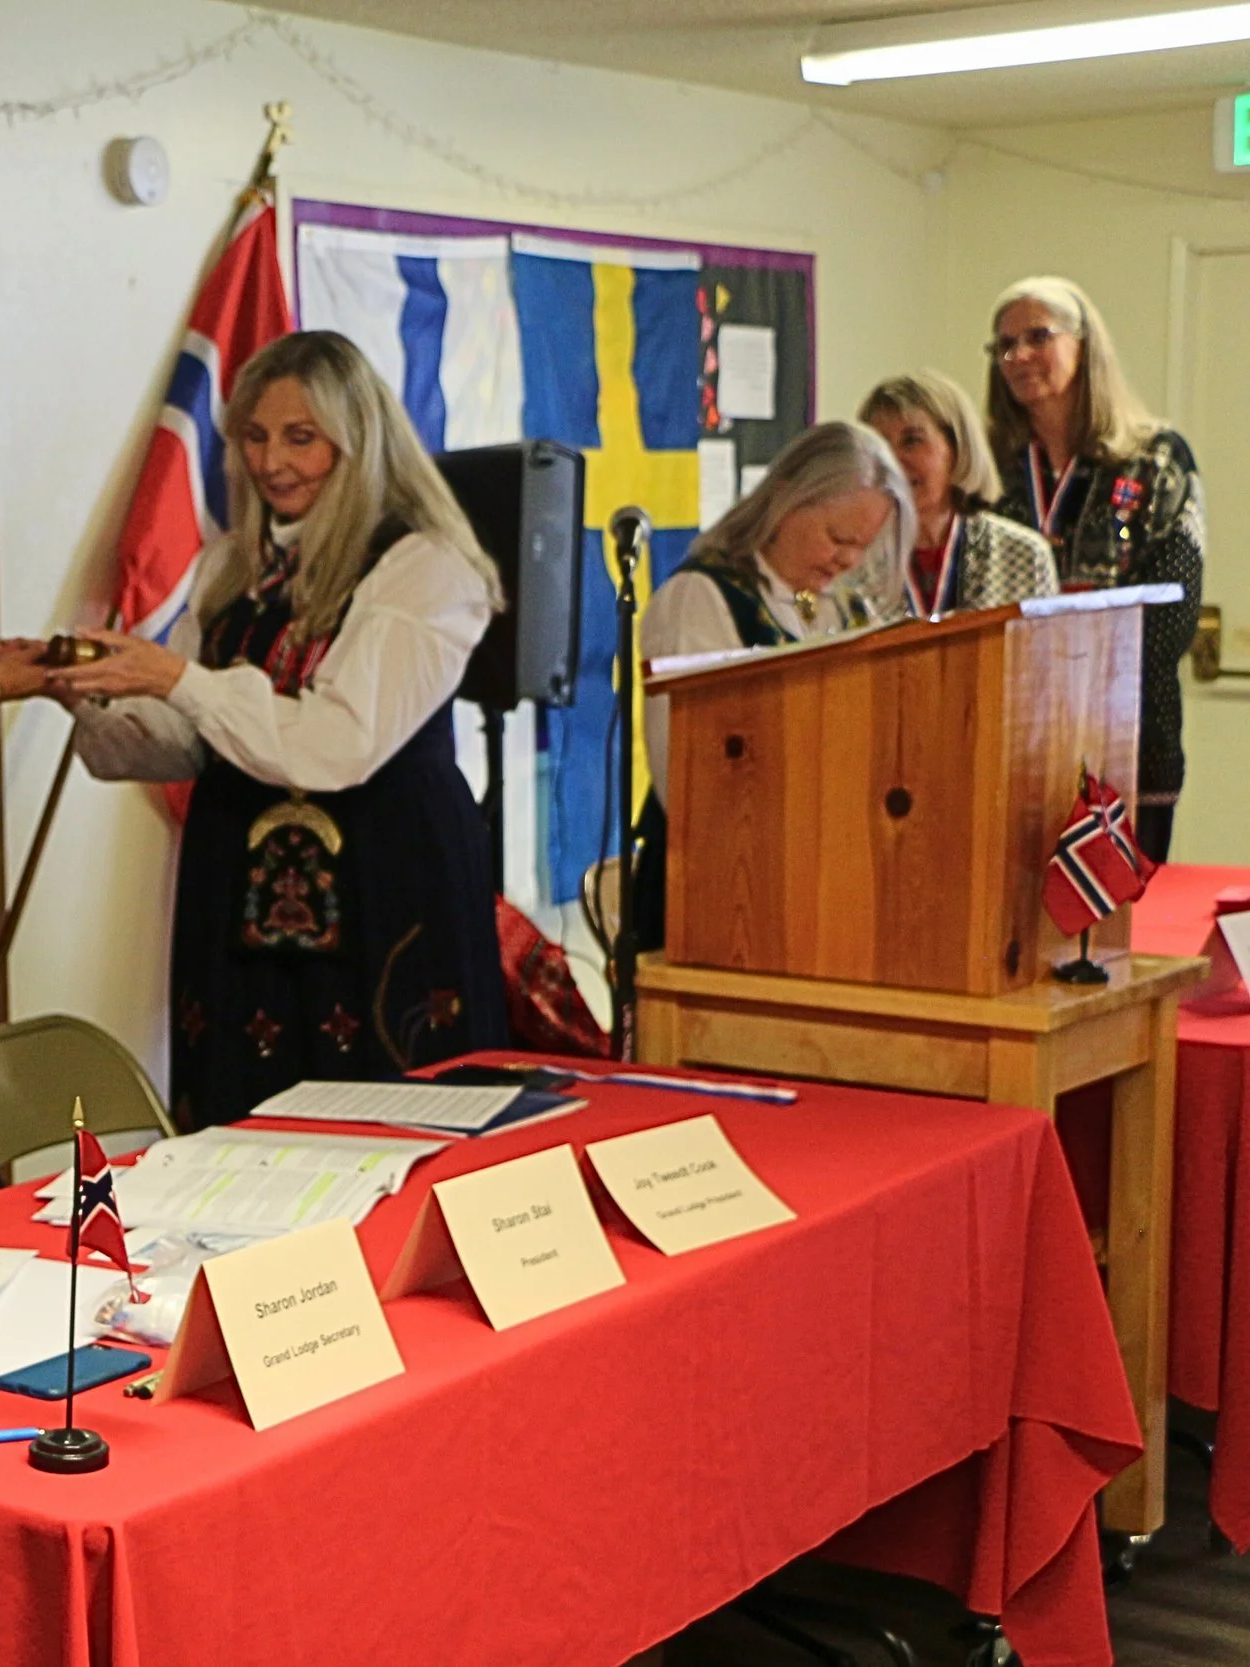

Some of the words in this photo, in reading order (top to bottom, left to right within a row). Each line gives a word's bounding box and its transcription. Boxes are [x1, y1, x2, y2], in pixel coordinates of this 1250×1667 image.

[491, 1211, 531, 1233] Sharon
[520, 1249, 559, 1268] President
[254, 1294, 298, 1319] Sharon
[300, 1280, 338, 1303] Jordan
[262, 1349, 292, 1368] Grand
[290, 1340, 320, 1357] Lodge
[319, 1324, 361, 1346] Secretary
